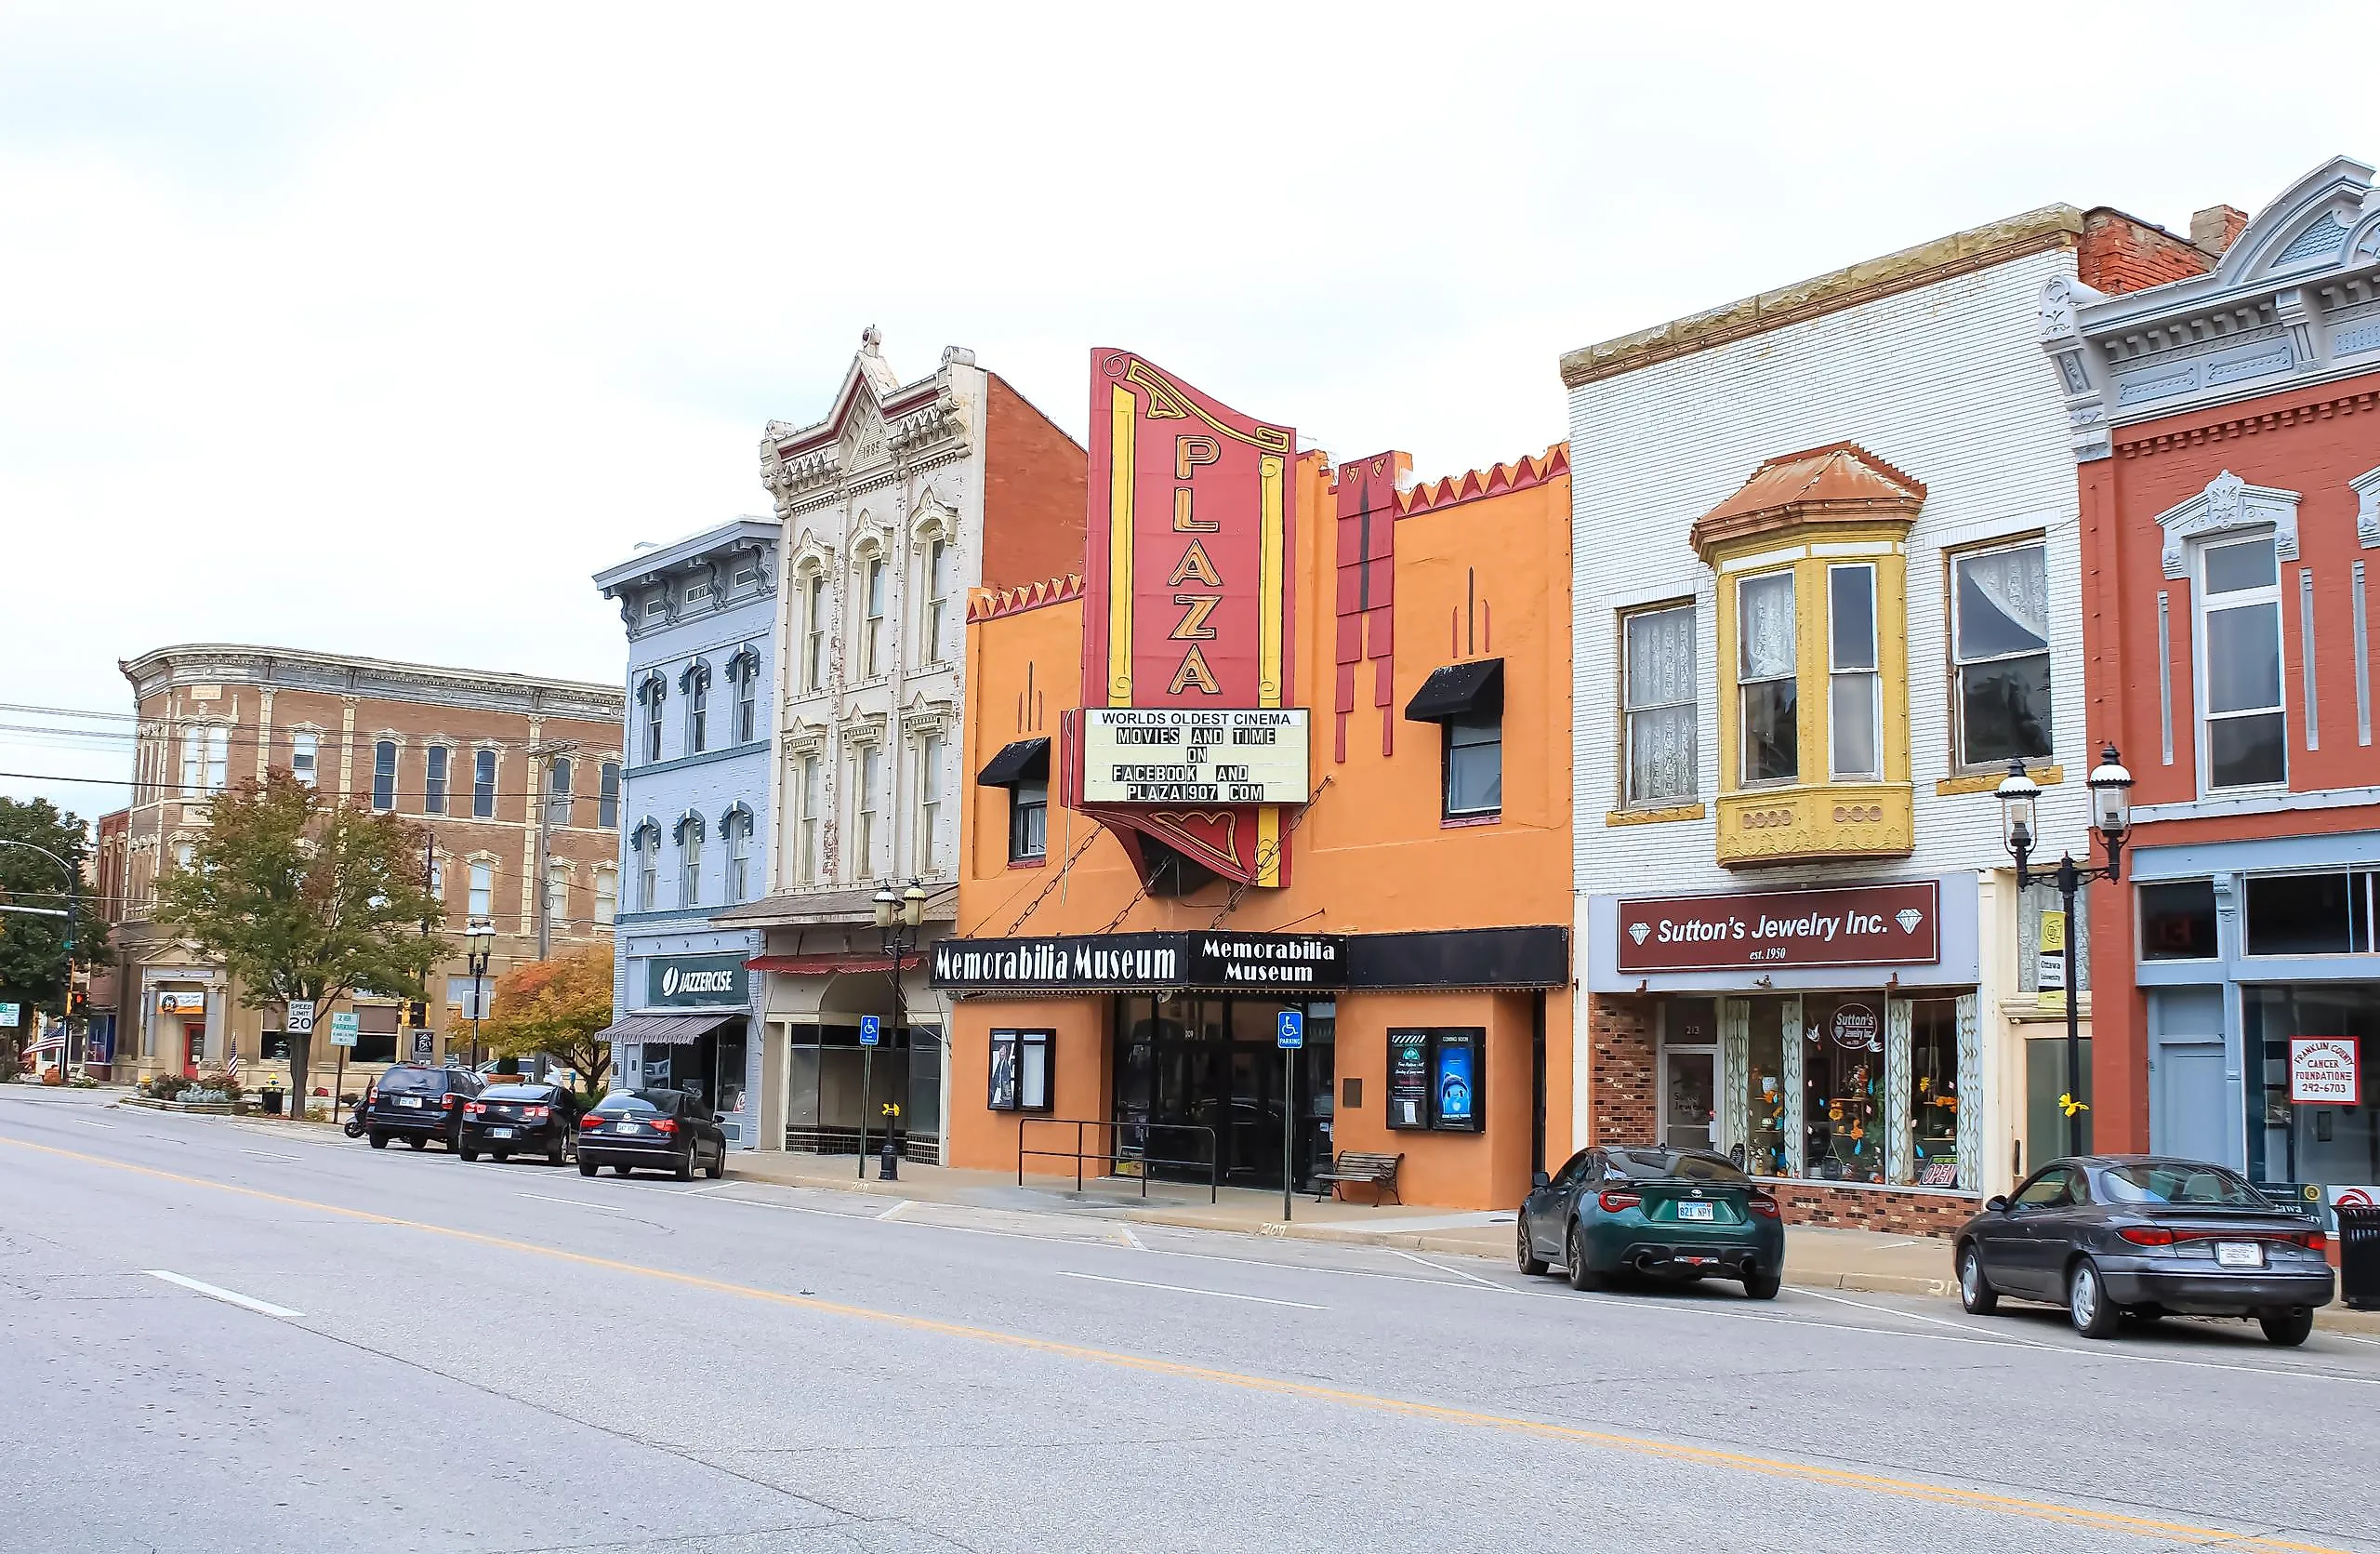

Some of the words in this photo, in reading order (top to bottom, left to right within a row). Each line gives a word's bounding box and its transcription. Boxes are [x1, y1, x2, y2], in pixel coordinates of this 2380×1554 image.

[1167, 434, 1224, 695] PLAZA
[1103, 712, 1166, 724] WORLDS
[1171, 712, 1229, 725] OLDEST
[1234, 713, 1291, 725] CINEMA
[1117, 727, 1180, 744] MOVIES
[1192, 727, 1223, 744] AND
[1233, 727, 1276, 744] TIME
[1187, 747, 1208, 763] ON
[1112, 764, 1197, 781] FACEBOOK
[1216, 765, 1248, 781] AND
[1229, 784, 1263, 801] COM
[1658, 917, 1746, 943] Sutton's
[1751, 912, 1840, 942] Jewelry
[1845, 910, 1888, 935] Inc.
[1202, 938, 1335, 960] Memorabilia
[1749, 950, 1765, 960] est.
[1765, 947, 1786, 960] 1950
[934, 943, 1068, 980] Memorabilia
[1072, 943, 1176, 979] Museum
[1224, 962, 1313, 982] Museum
[289, 1016, 311, 1029] 20
[1836, 1013, 1874, 1026] Sutton's
[2294, 1042, 2330, 1065] FRANKLIN
[2331, 1044, 2355, 1066] COUNTY
[2307, 1059, 2339, 1069] CANCER
[2301, 1082, 2347, 1094] 292-6703
[1922, 1163, 1957, 1184] OPEN
